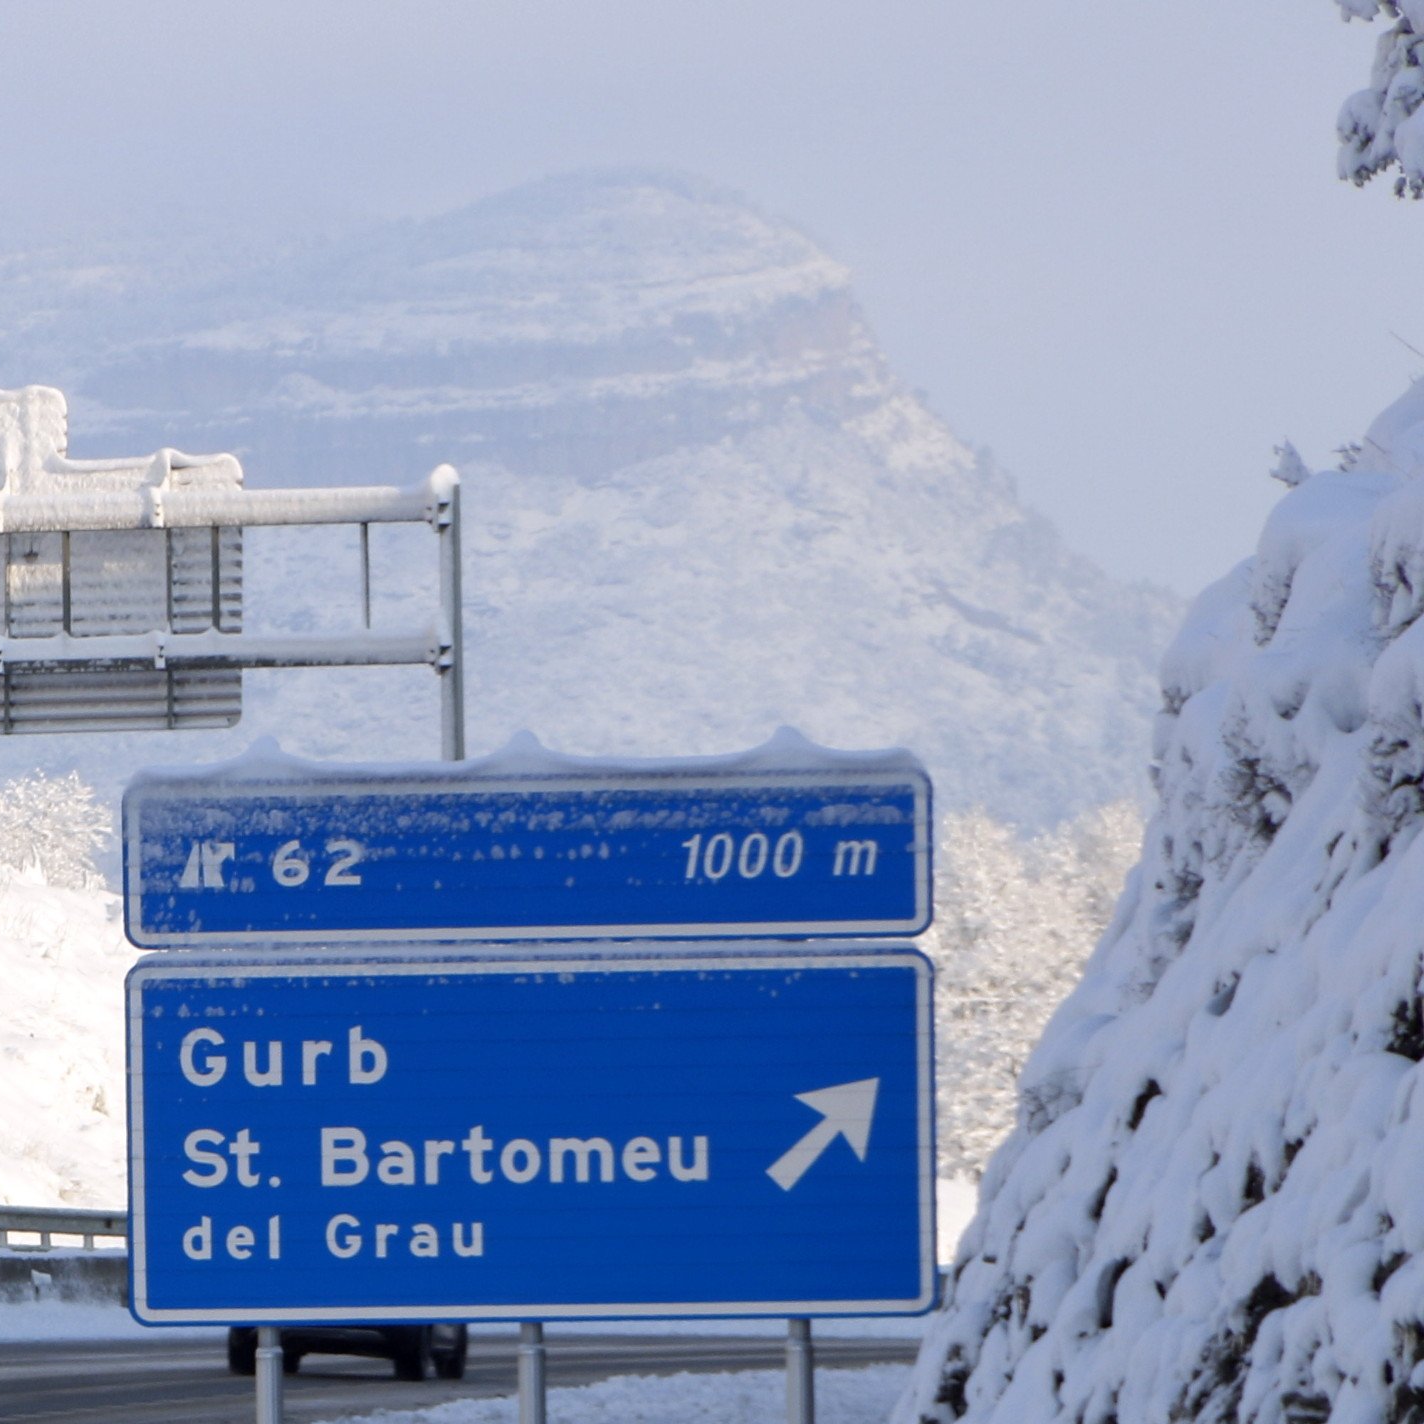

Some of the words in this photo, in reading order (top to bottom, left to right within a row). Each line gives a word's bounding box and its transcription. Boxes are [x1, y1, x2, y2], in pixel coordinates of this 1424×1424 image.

[271, 839, 363, 887] 62
[682, 831, 804, 879] 1000
[833, 840, 879, 876] m
[180, 1024, 389, 1087] Gurb
[182, 1127, 282, 1188] St.
[320, 1124, 710, 1187] Bartomeu
[182, 1214, 281, 1261] del
[325, 1212, 484, 1260] Grau
